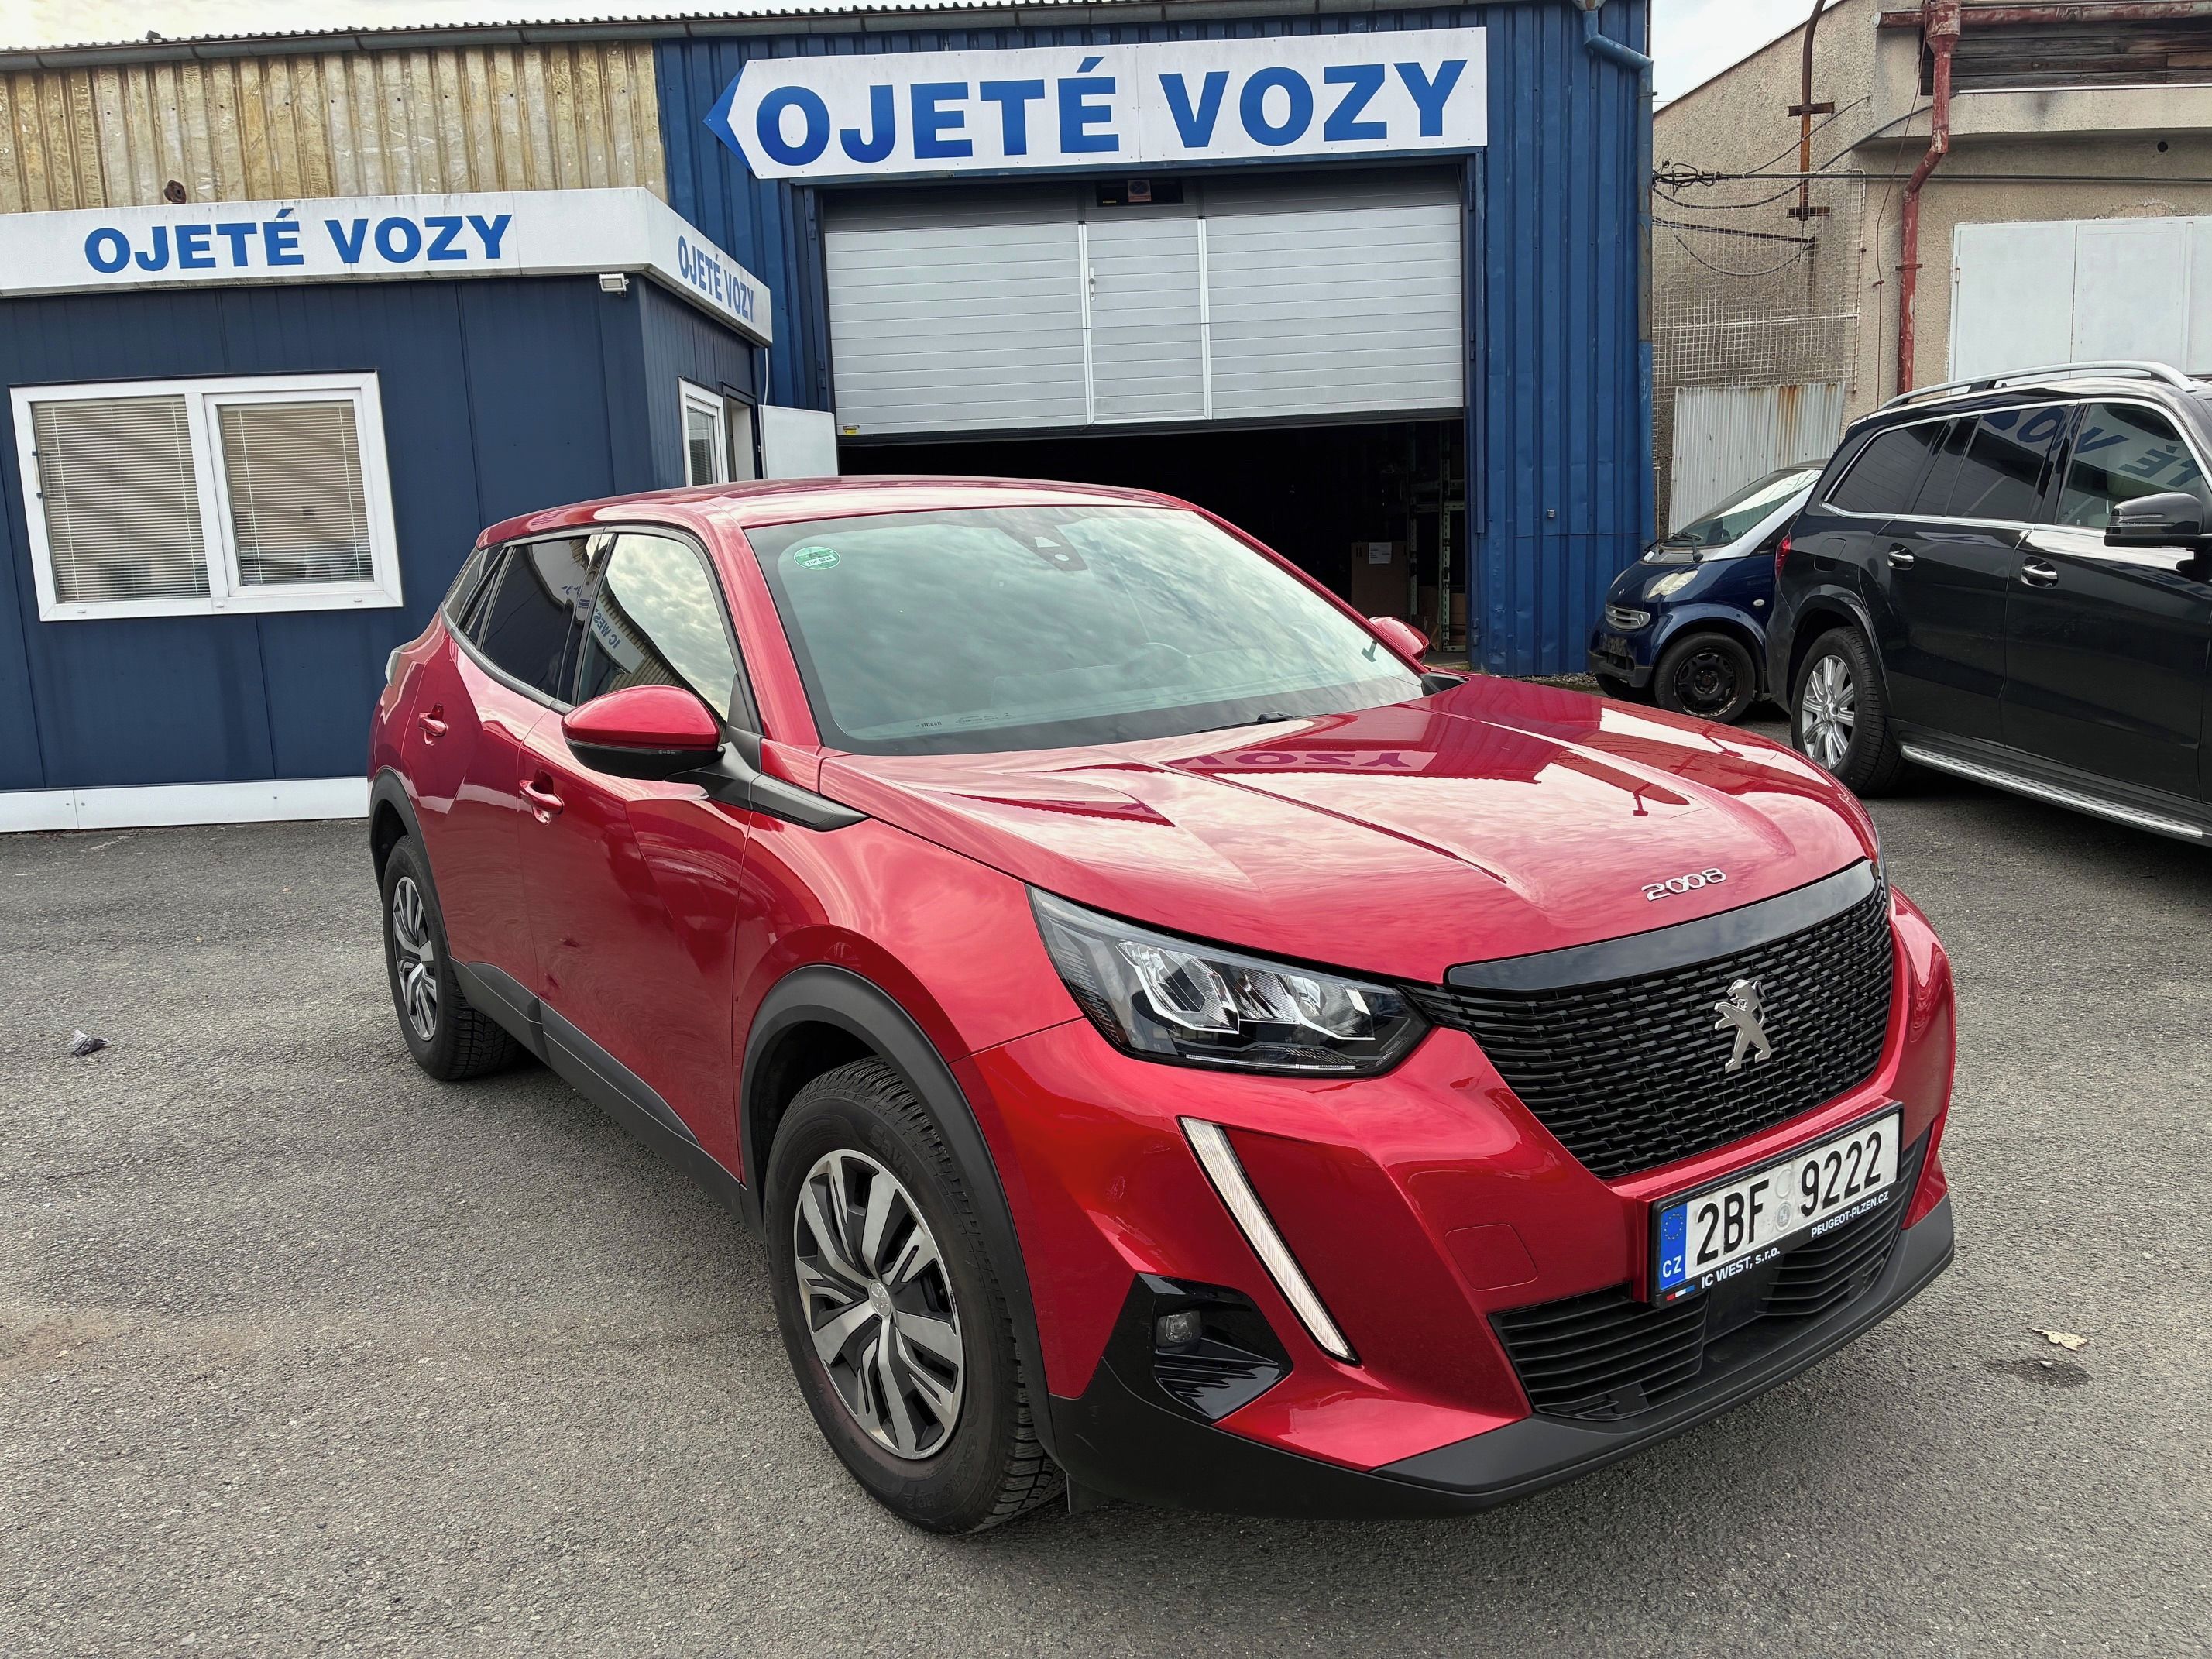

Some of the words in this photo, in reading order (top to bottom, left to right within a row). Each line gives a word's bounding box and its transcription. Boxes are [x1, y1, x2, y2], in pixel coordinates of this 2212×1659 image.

[754, 56, 1120, 166] OJETÉ
[1157, 59, 1468, 149] VOZY
[84, 208, 304, 273] OJETÉ
[325, 214, 513, 264] VOZY
[678, 235, 723, 302] OJETÉ
[723, 269, 754, 323] VOZY
[1641, 867, 1726, 902] 2008
[1696, 1178, 1770, 1266] 2BF
[1800, 1131, 1882, 1217] 9222
[1811, 1190, 1890, 1238] PEUGEOT-PLZEN.CZ
[1662, 1255, 1683, 1278] CZ
[1701, 1273, 1715, 1289] IC
[1715, 1255, 1753, 1283] WEST,
[1754, 1247, 1781, 1265] s.r.o.
